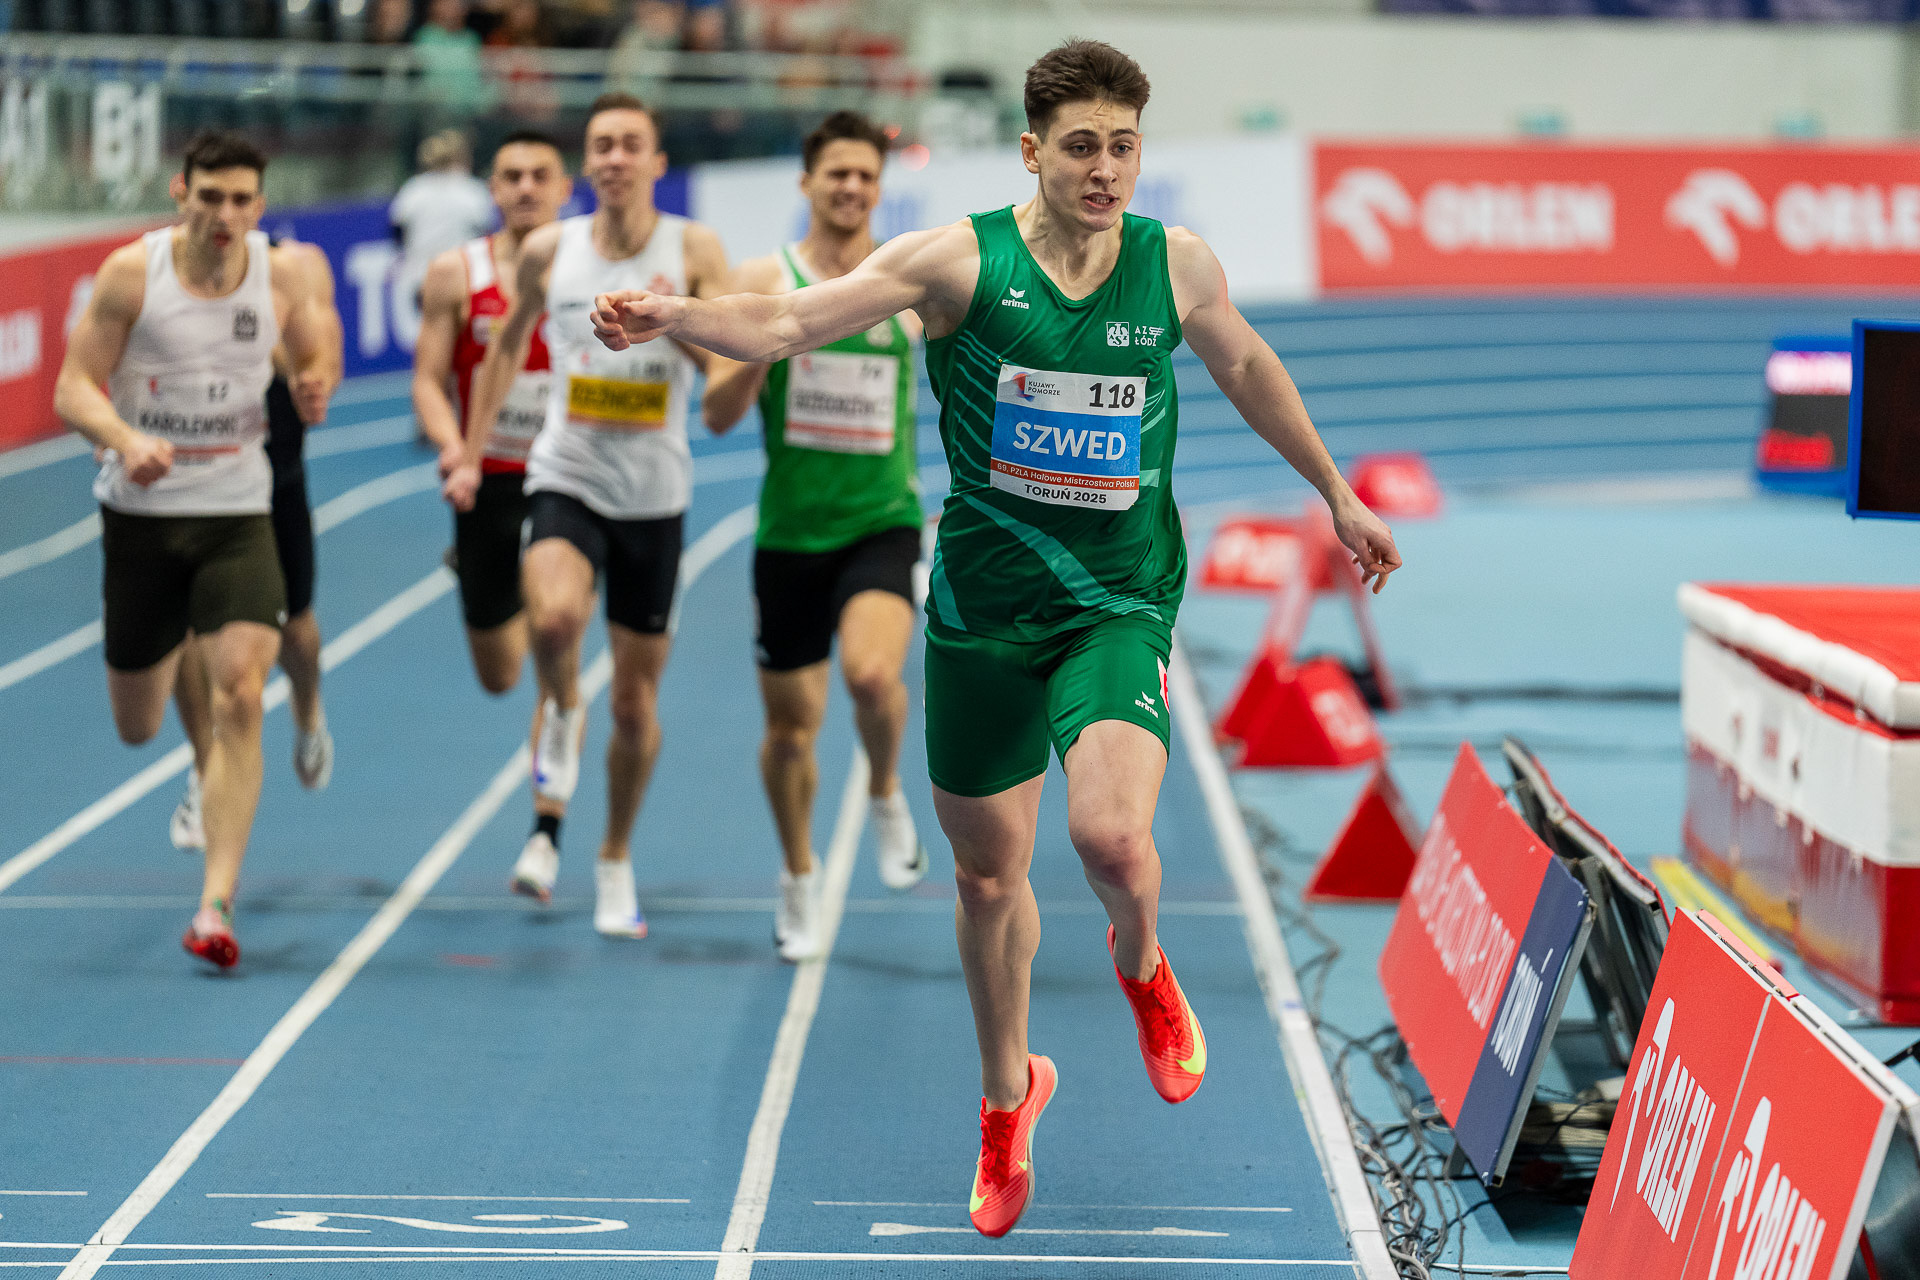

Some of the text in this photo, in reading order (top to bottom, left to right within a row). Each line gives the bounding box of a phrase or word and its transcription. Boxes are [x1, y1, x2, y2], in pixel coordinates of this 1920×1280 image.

[1420, 180, 1616, 255] ORLEN
[1002, 299, 1030, 310] erima
[1027, 387, 1060, 396] POMORZE
[1028, 381, 1055, 389] KUJAWY
[1089, 382, 1136, 409] 118
[1012, 421, 1127, 461] SZWED
[997, 463, 1009, 473] 69.
[1010, 466, 1029, 478] PZLA
[1063, 476, 1114, 488] Mistrzostwa
[1115, 480, 1136, 488] Polski
[1024, 483, 1107, 504] TORUŃ 2025
[1134, 698, 1159, 719] erima
[1636, 1054, 1717, 1244] ORLEN
